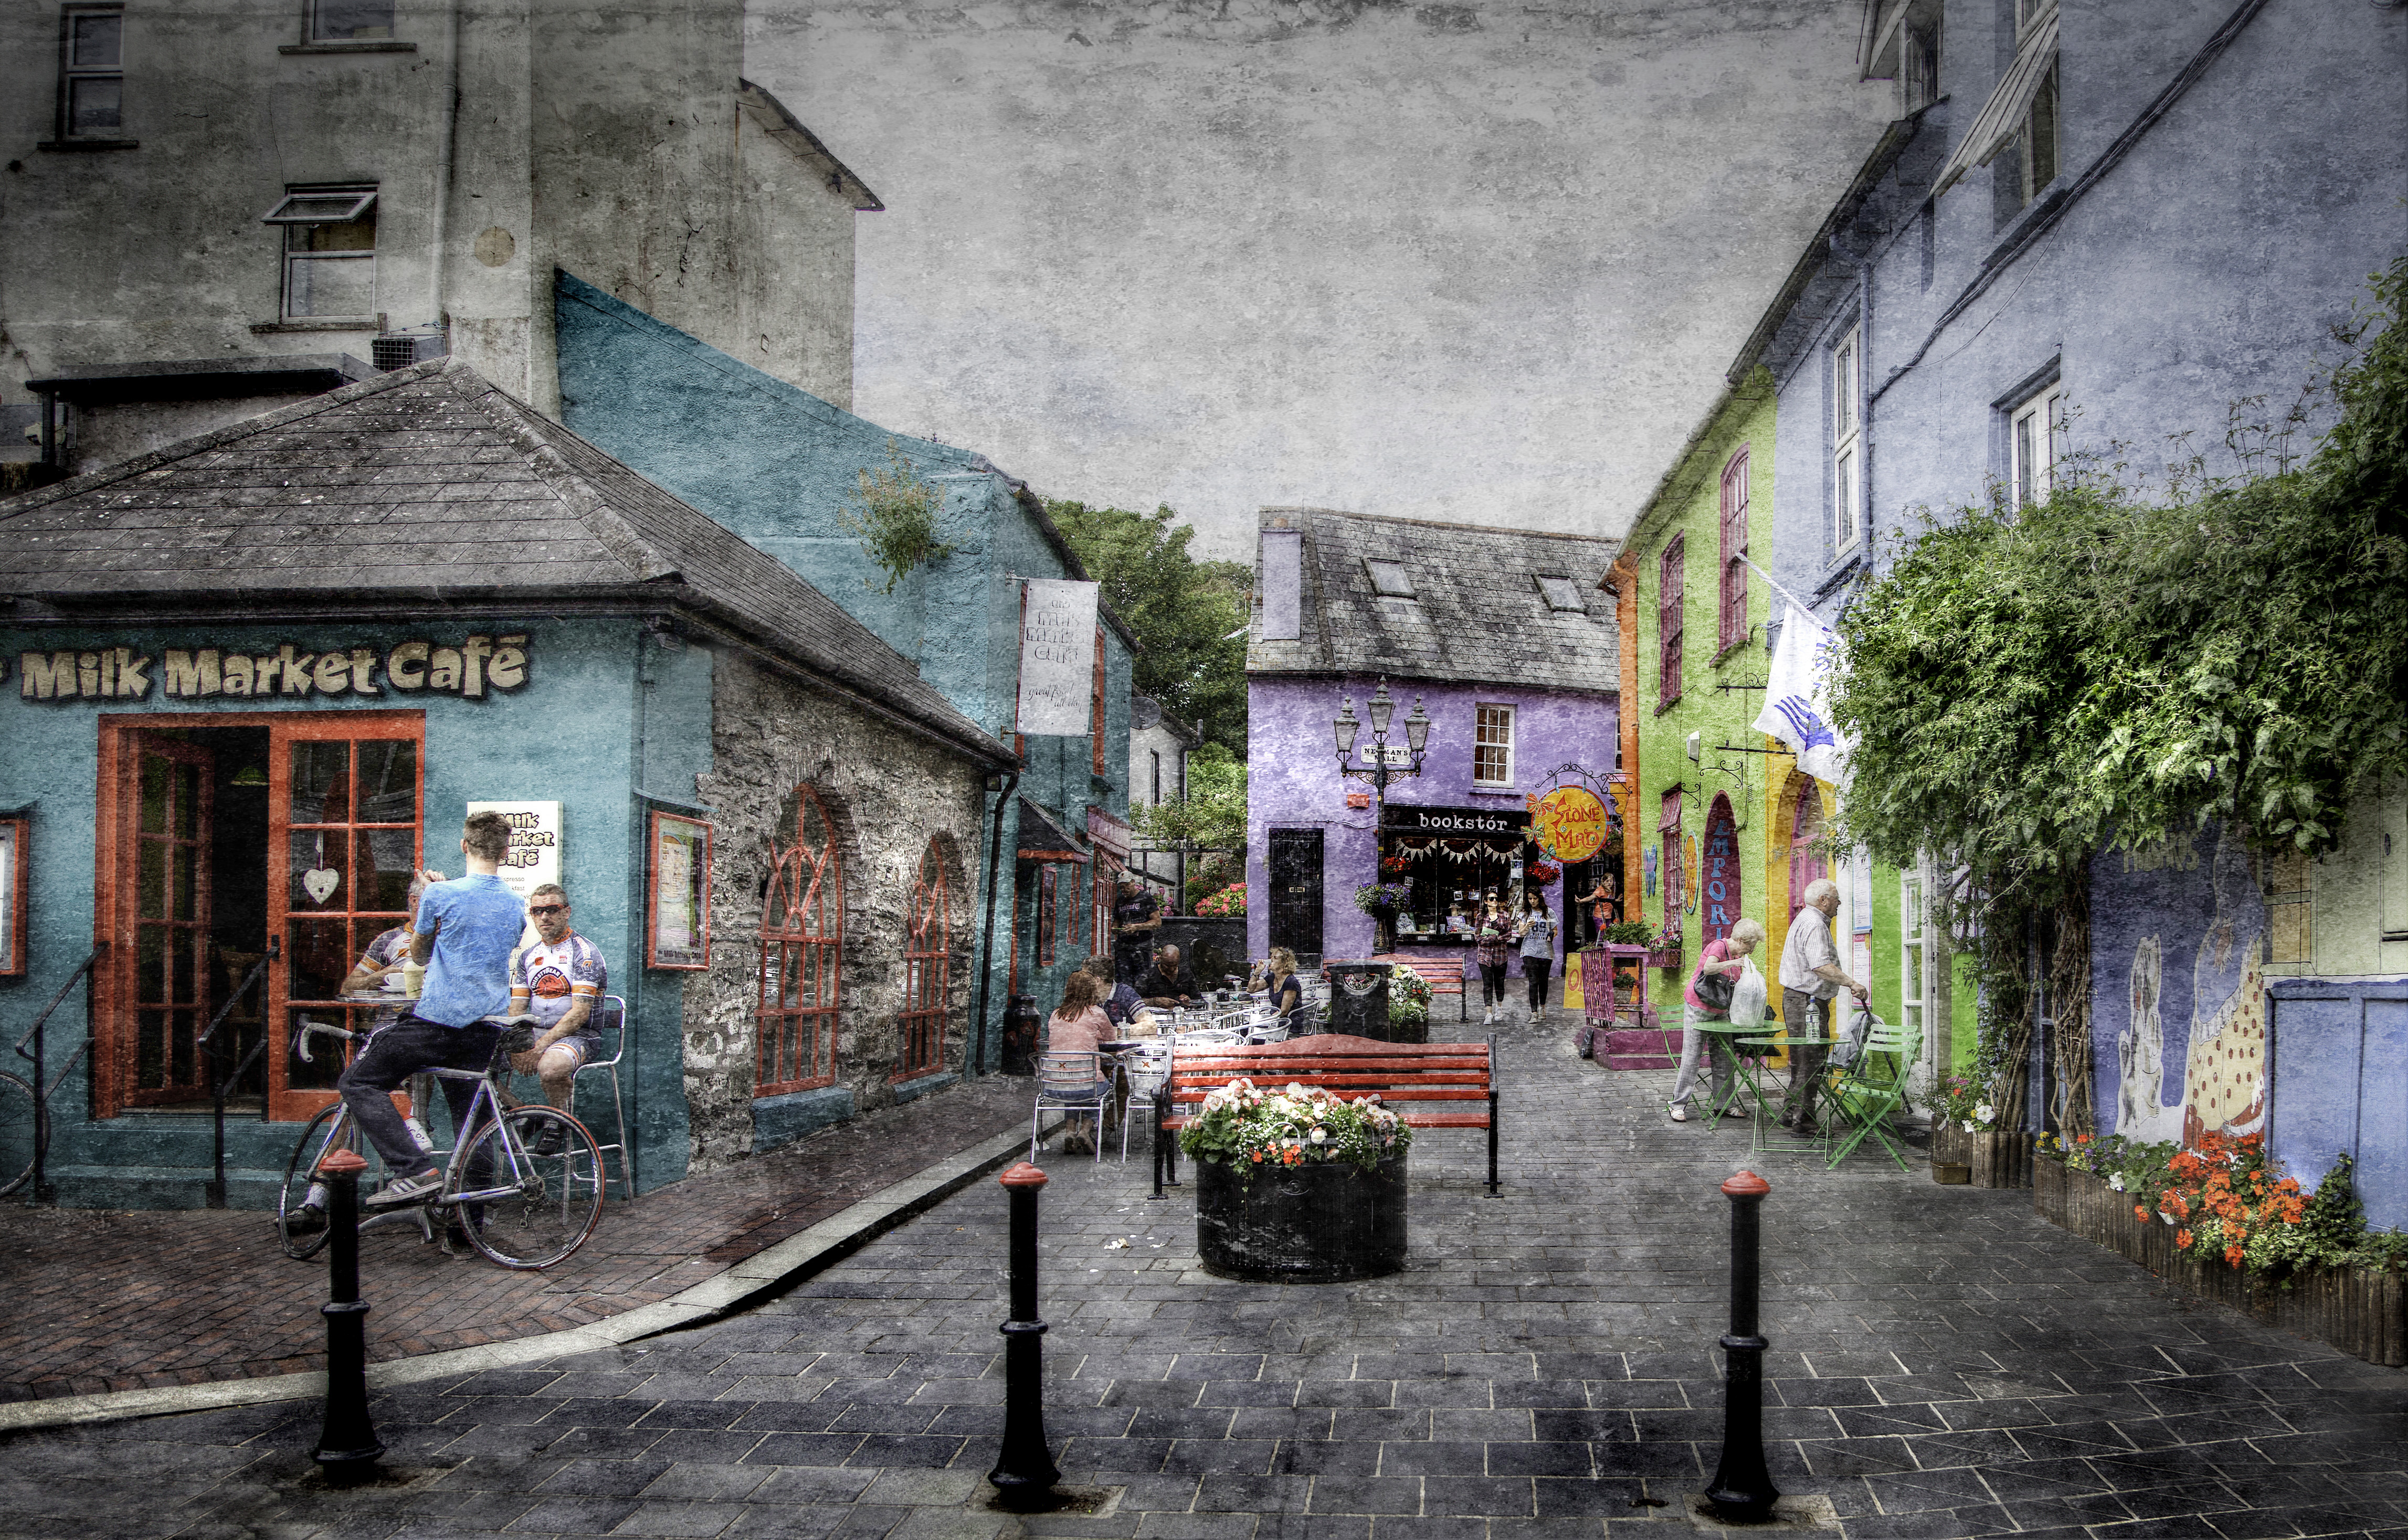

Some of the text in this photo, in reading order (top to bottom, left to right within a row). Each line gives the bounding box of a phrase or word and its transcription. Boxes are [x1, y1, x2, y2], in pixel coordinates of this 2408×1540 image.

[1038, 611, 1080, 627] Milk
[1027, 627, 1088, 644] Market
[21, 647, 152, 698] Milk
[165, 644, 378, 697] Market
[1025, 683, 1074, 701] great food
[1054, 696, 1083, 713] all day
[1419, 813, 1507, 831] bookstór
[509, 831, 554, 846] rket
[1555, 829, 1599, 849] MAD
[1707, 820, 1731, 940] EMPORI
